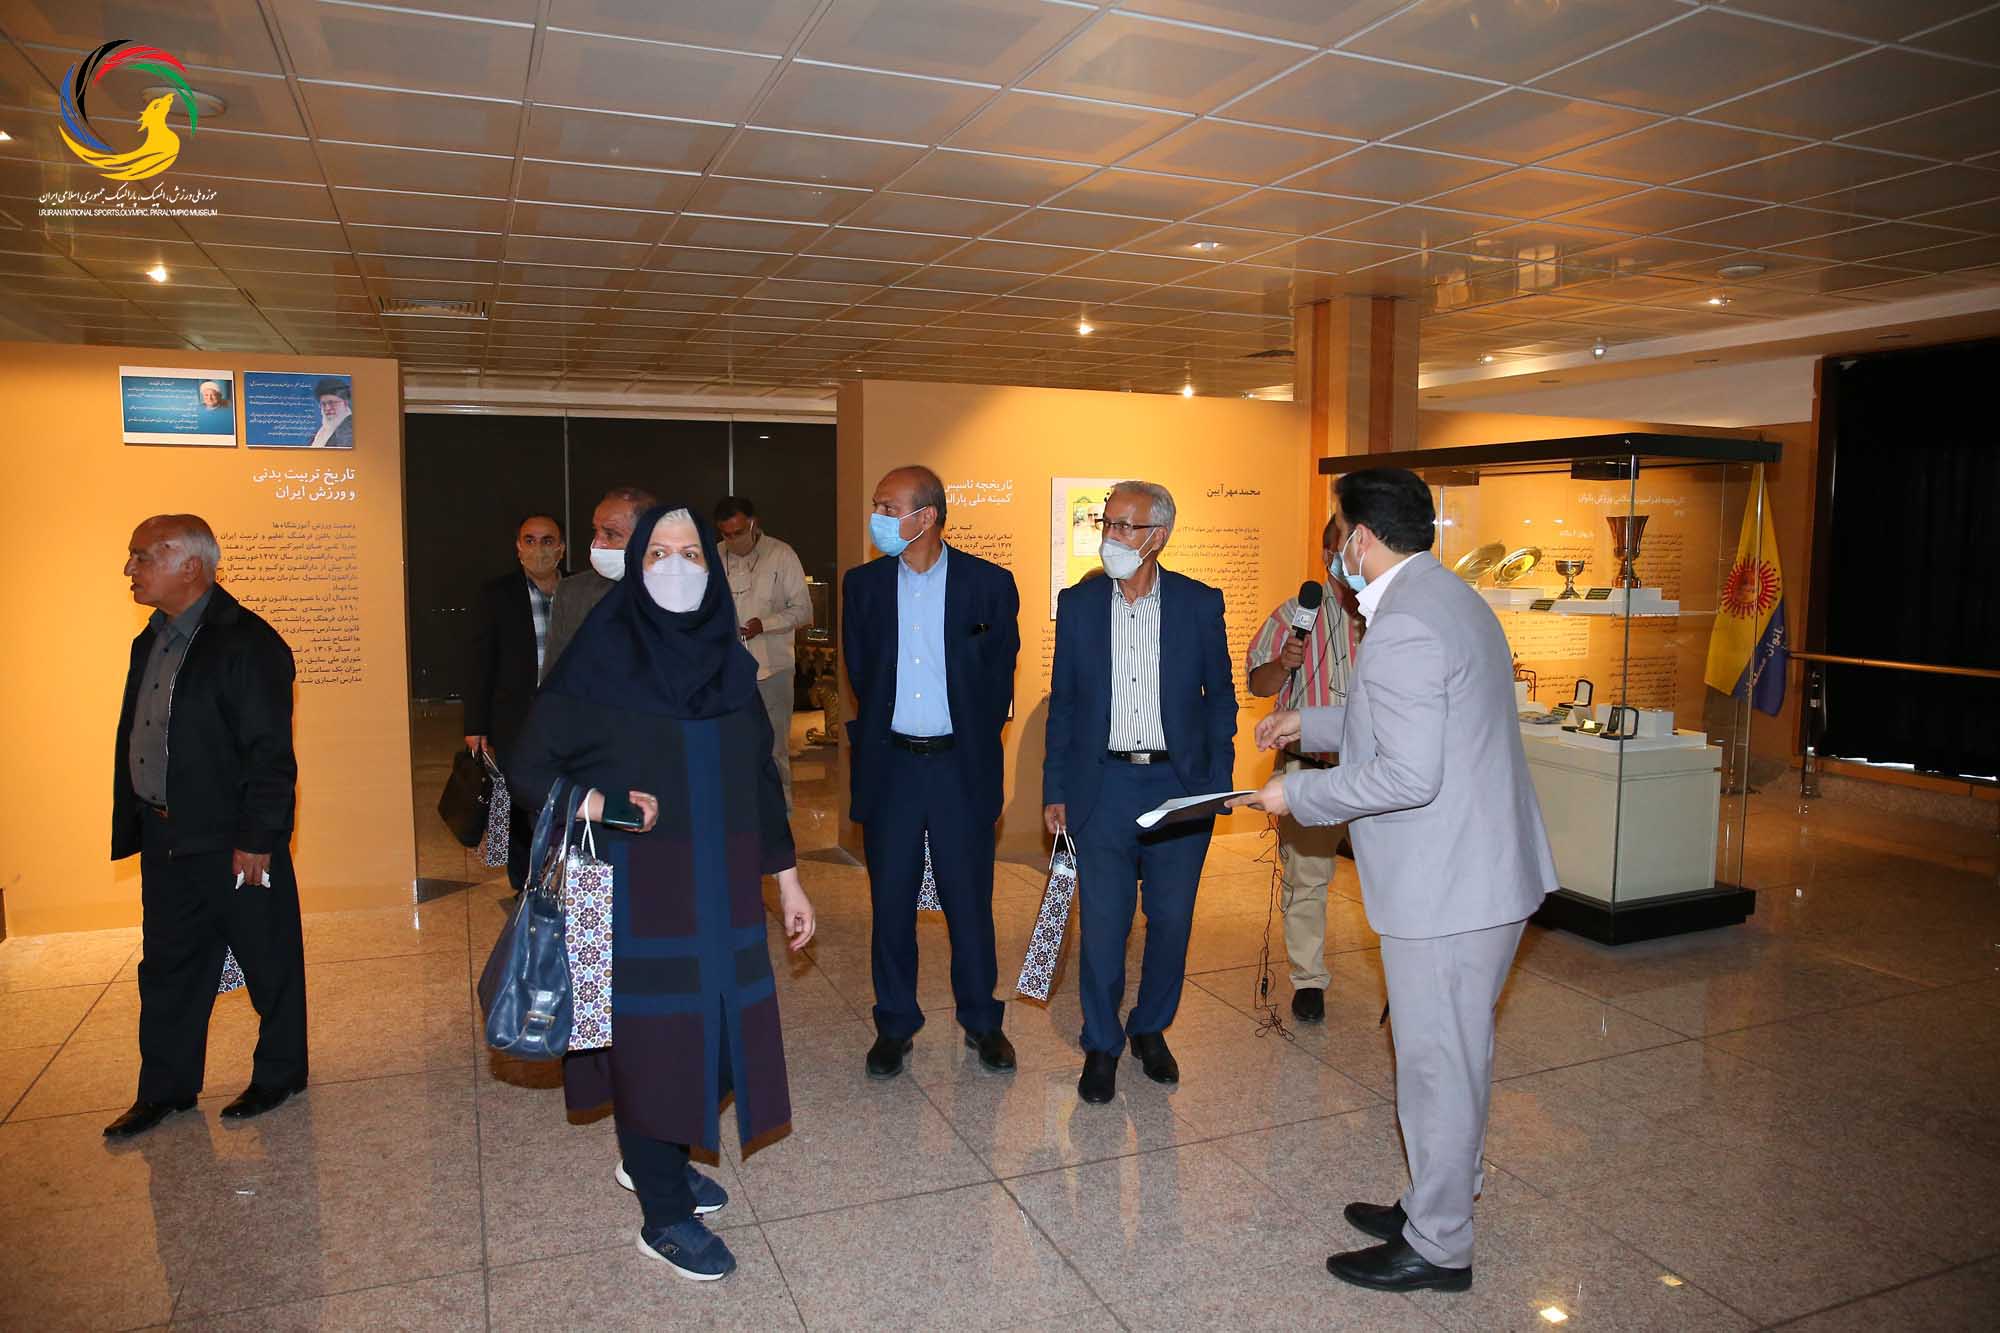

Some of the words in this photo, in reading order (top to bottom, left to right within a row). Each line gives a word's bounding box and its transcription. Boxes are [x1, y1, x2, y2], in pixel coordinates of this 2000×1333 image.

[252, 468, 281, 483] بدنی
[284, 468, 320, 483] تربیت
[323, 468, 355, 485] تاریخ
[275, 485, 305, 500] ایران
[975, 479, 1013, 492] تاریخچه
[309, 486, 346, 501] ورزش
[350, 488, 356, 501] و
[969, 493, 986, 506] ملی
[987, 493, 1013, 505] کمیته
[220, 531, 237, 540] ایران
